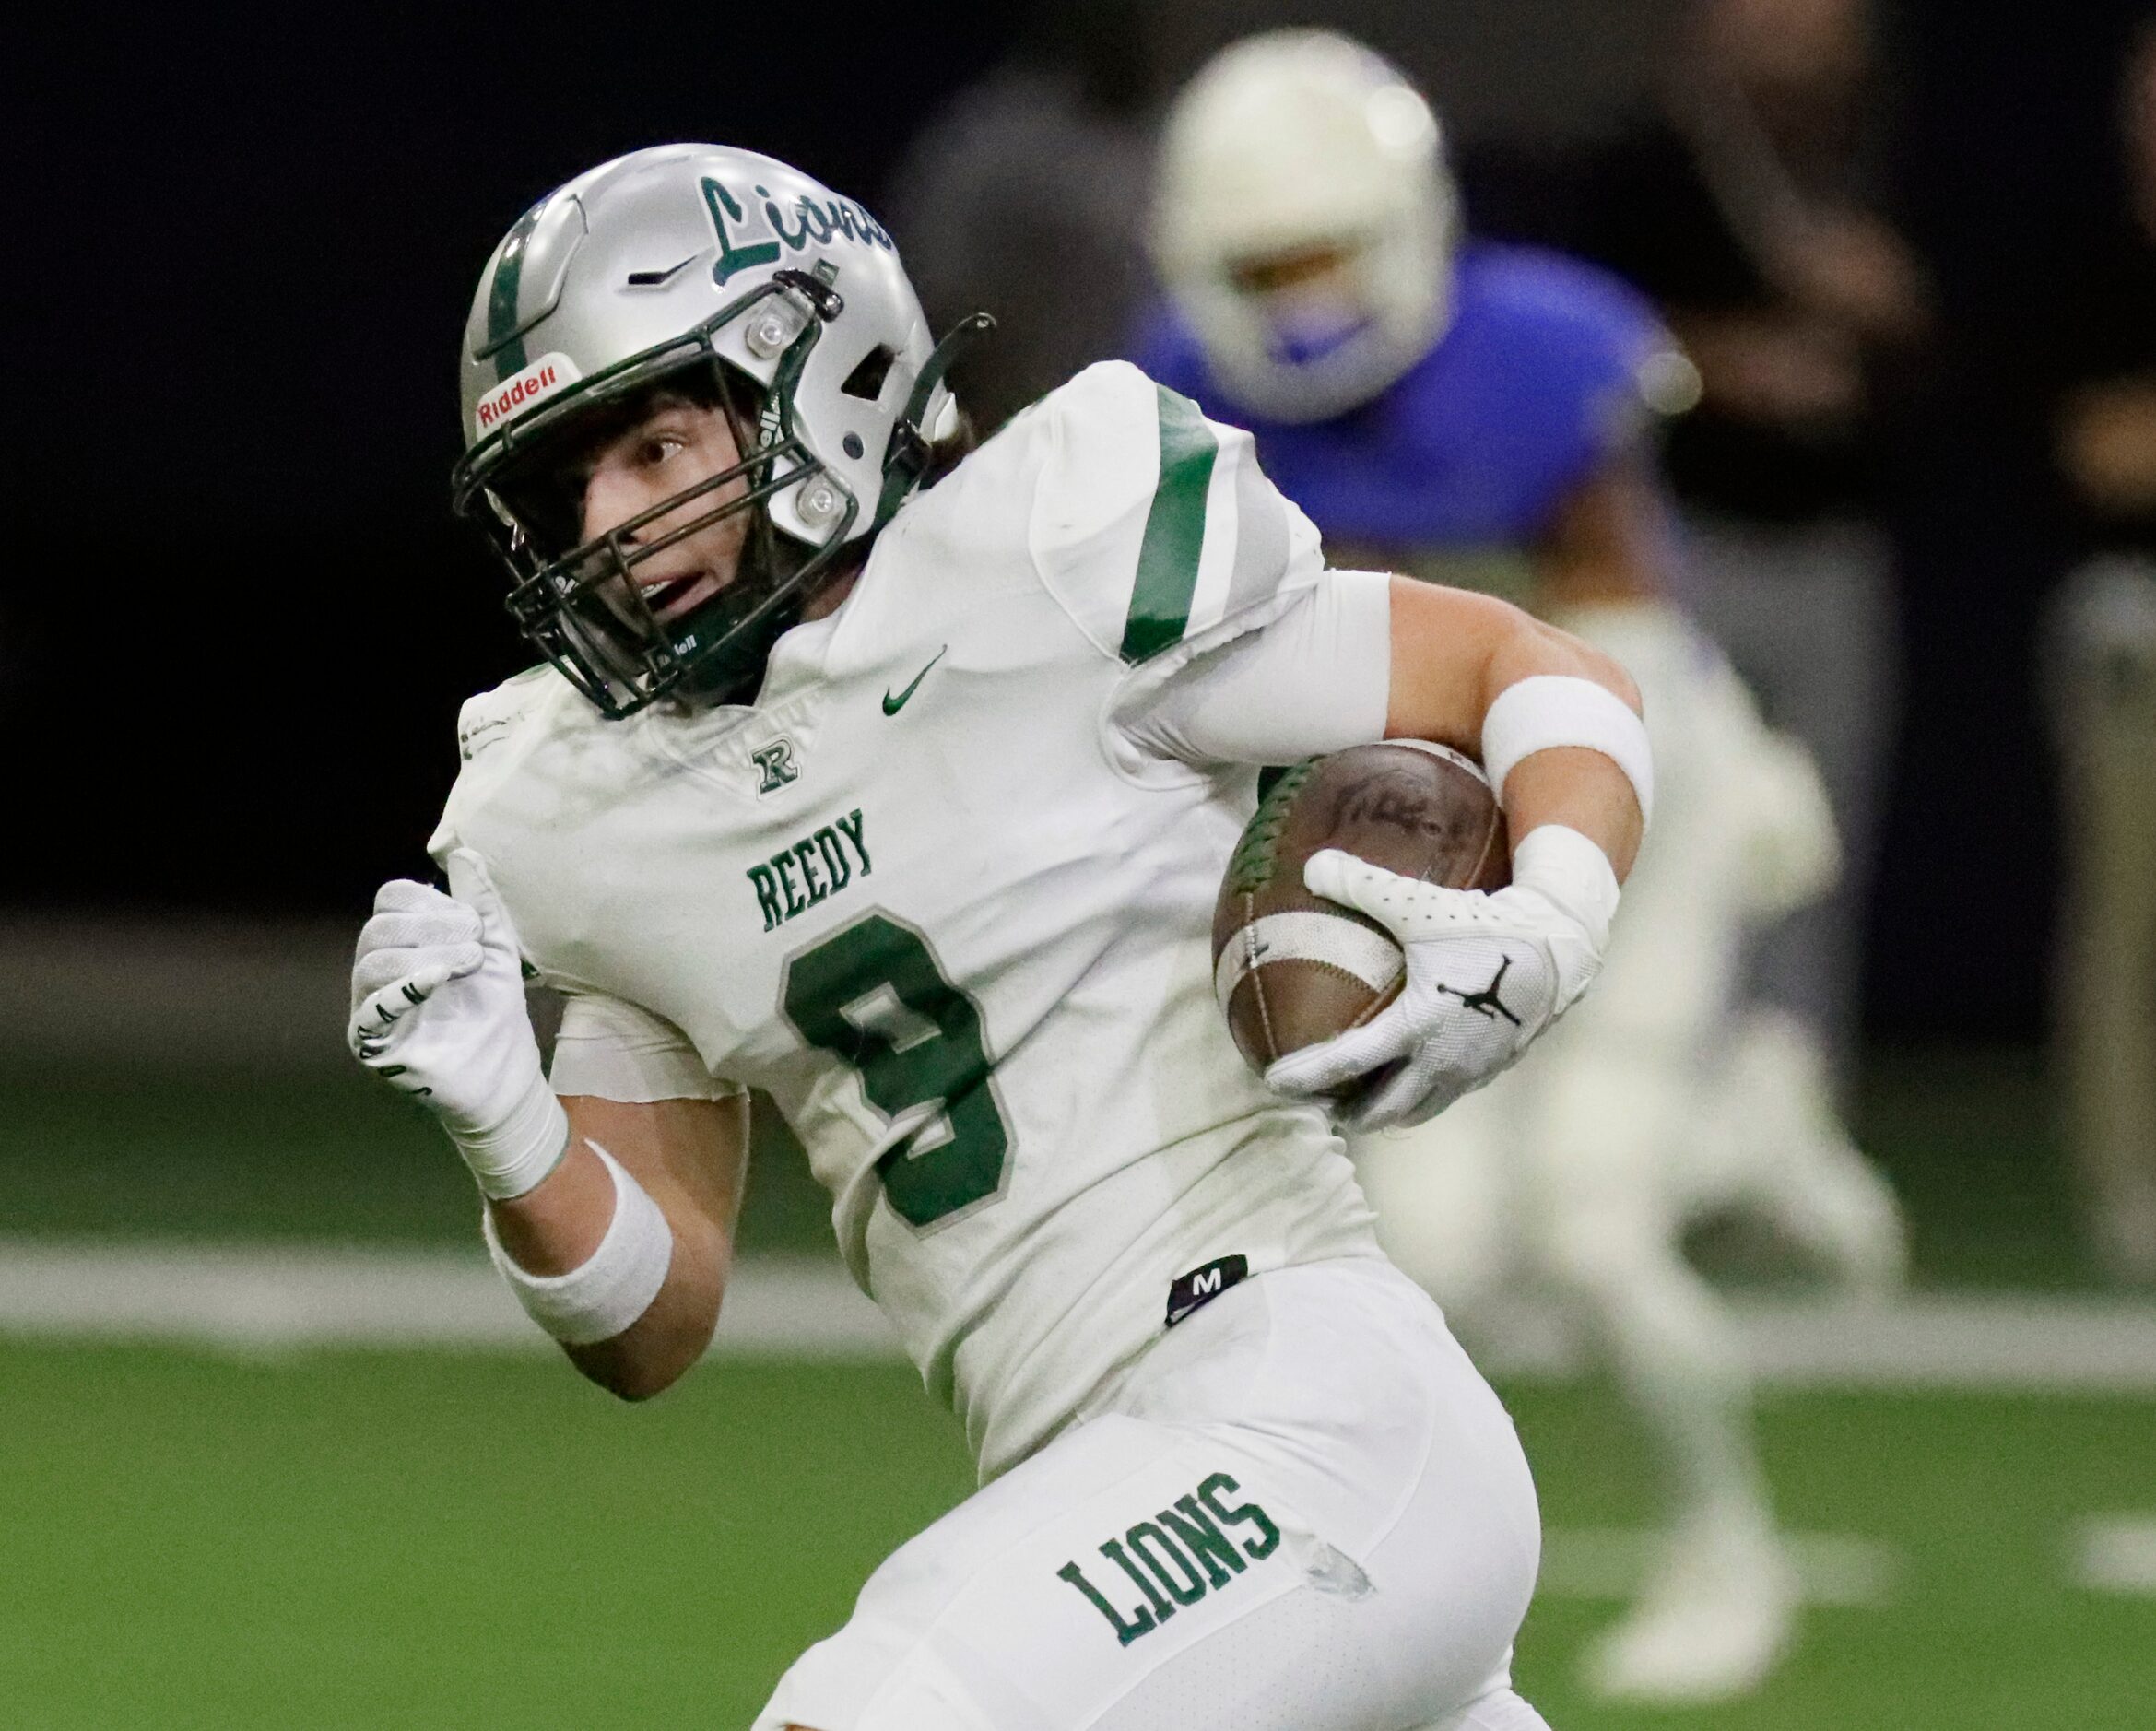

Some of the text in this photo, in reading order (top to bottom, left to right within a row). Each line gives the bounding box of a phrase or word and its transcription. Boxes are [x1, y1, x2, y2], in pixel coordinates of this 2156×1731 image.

[477, 366, 556, 428] Riddell
[752, 738, 798, 794] R
[747, 807, 871, 933] REEDY
[776, 903, 1019, 1240] 9
[1193, 1268, 1222, 1296] M
[1056, 1472, 1280, 1647] LIONS
